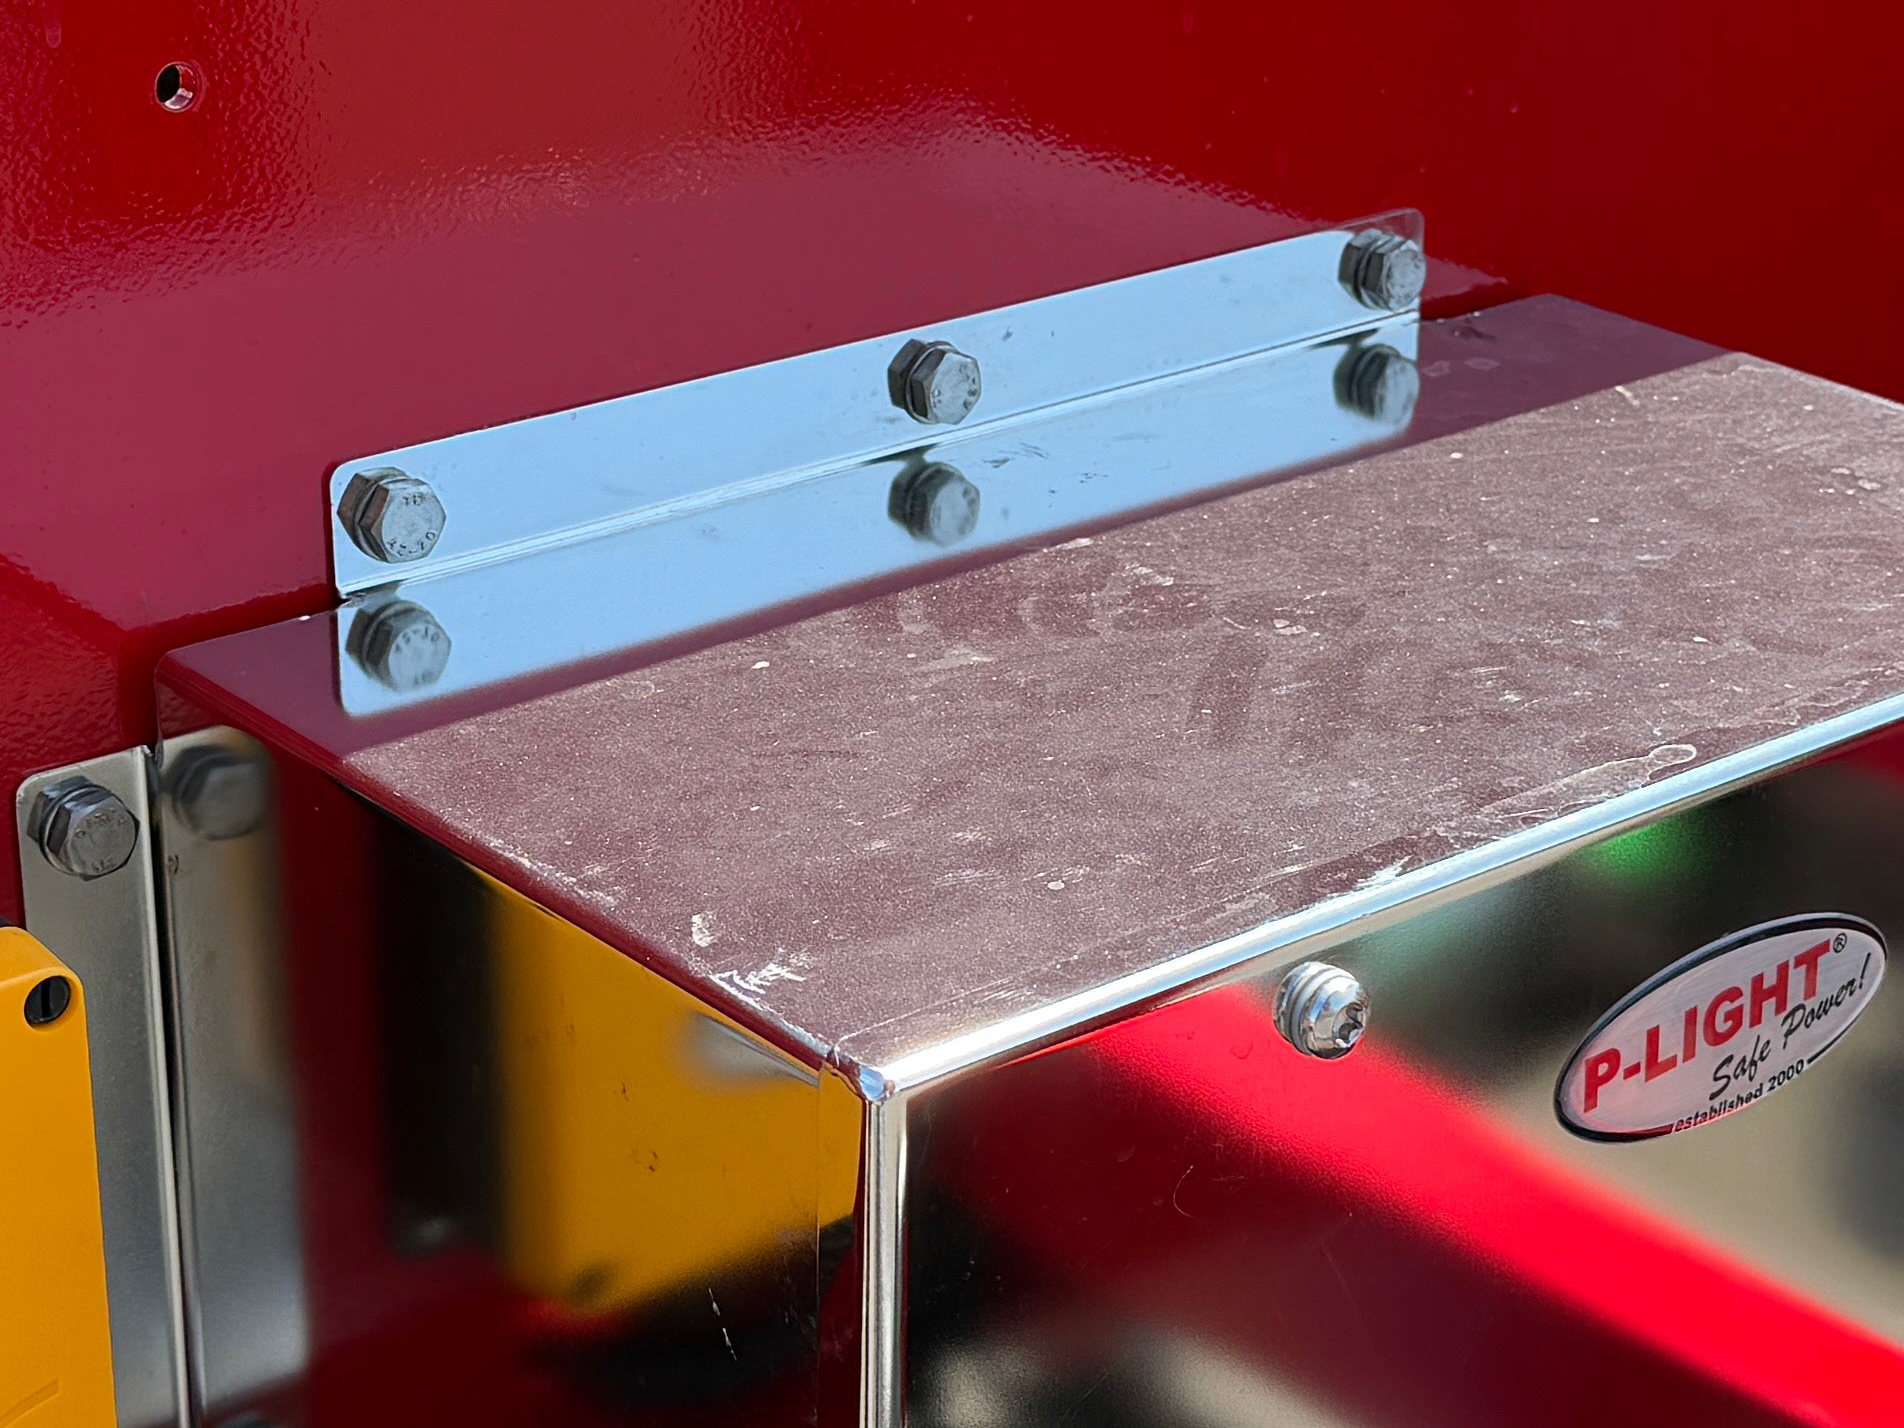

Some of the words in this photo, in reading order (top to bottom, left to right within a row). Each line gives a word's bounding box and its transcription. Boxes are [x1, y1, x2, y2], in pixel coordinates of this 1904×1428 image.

[1709, 1035, 1770, 1101] Safe
[1781, 952, 1871, 1049] Power!
[1674, 1083, 1763, 1133] established
[1768, 1059, 1804, 1091] 2000
